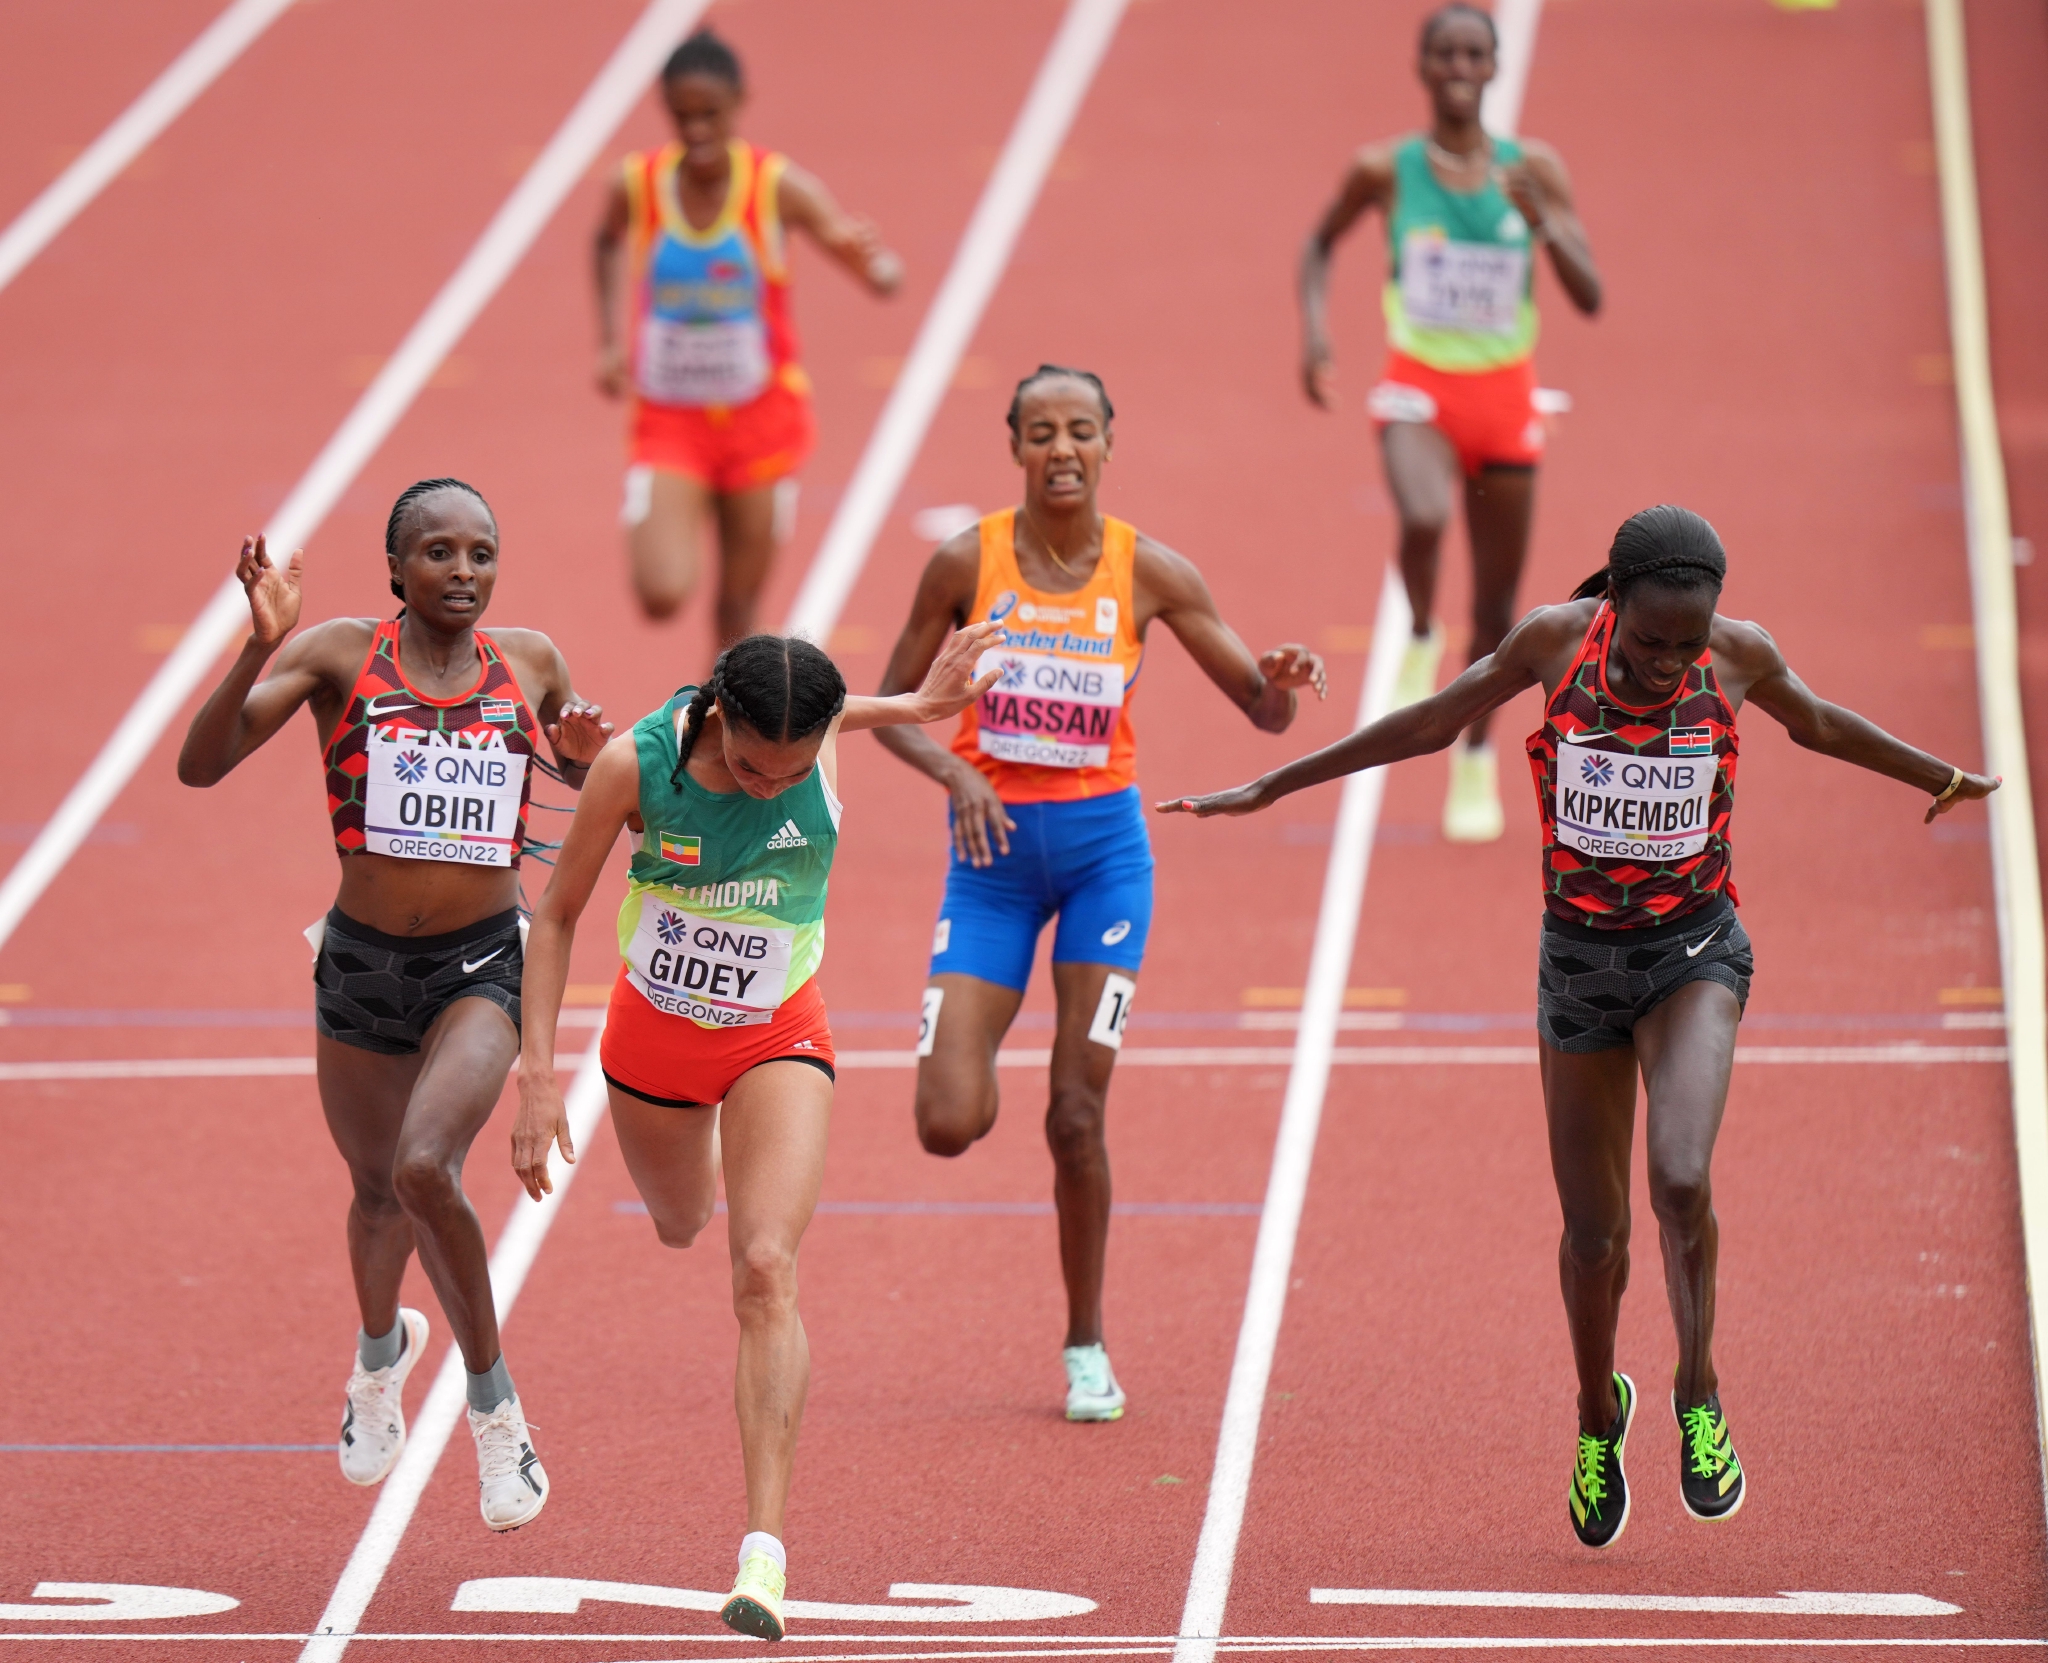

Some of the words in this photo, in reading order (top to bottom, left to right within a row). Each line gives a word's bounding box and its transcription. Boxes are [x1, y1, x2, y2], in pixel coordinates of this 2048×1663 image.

[1034, 665, 1103, 696] QNB
[983, 694, 1111, 738] HASSAN
[365, 724, 508, 753] KENYA
[990, 738, 1089, 765] OREGON22
[435, 757, 506, 787] QNB
[1621, 763, 1695, 790] QNB
[400, 792, 496, 832] OBIRI
[1563, 787, 1703, 832] KIPKEMBOI
[389, 838, 498, 863] OREGON22
[767, 836, 808, 850] adidas
[1577, 835, 1685, 858] OREGON22
[693, 927, 768, 960] QNB
[650, 948, 758, 999] GIDEY
[646, 986, 748, 1025] OREGON22
